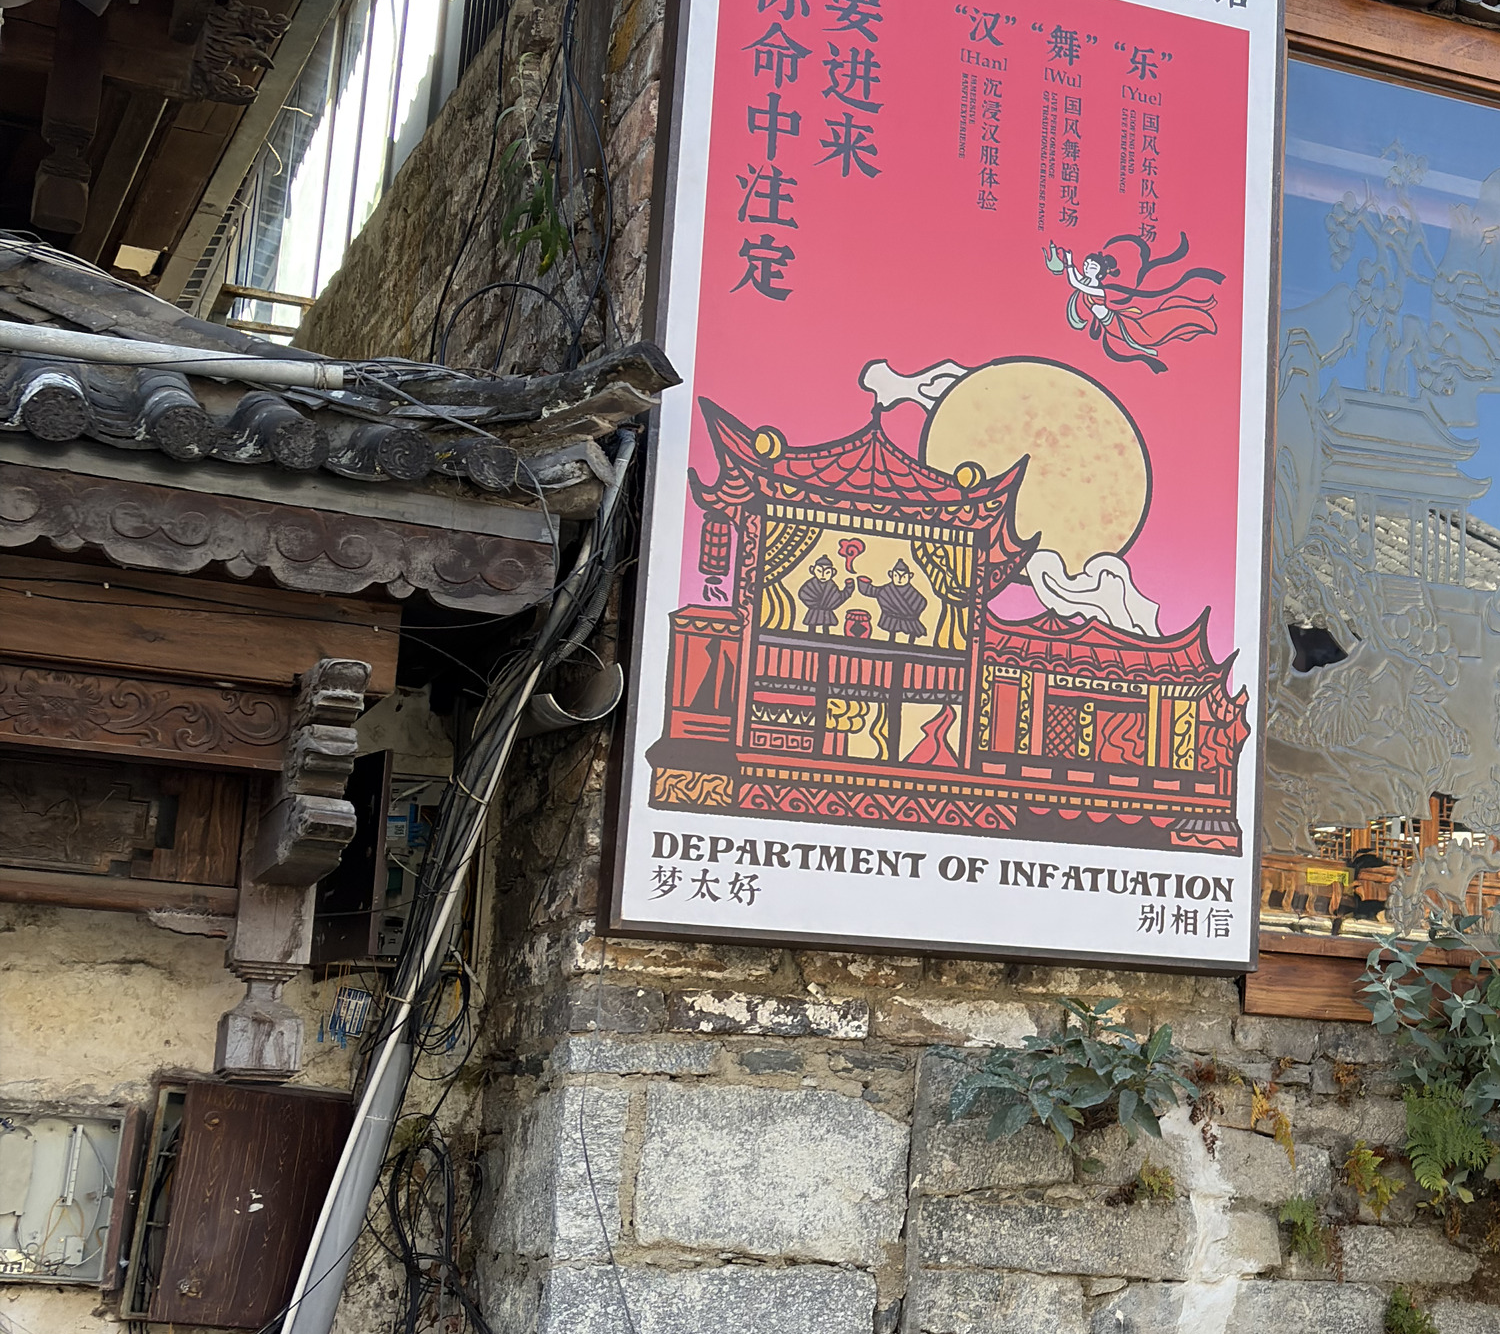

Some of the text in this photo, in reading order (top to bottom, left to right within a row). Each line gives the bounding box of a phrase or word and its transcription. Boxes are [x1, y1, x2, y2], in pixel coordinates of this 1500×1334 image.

[960, 48, 1008, 71] [Han]
[1044, 67, 1082, 89] [Wu]
[968, 74, 978, 125] IMMERSIVE
[1121, 85, 1162, 107] [Yue]
[958, 103, 968, 159] EXPERIENCE
[976, 77, 1003, 211] 沉浸汉服体验
[1048, 114, 1057, 179] PERFORMANCE
[1037, 90, 1050, 232] OF TRADITIONAL CHINESE DANCE
[1058, 95, 1082, 228] 国风舞蹈现场
[1119, 129, 1128, 194] PERFORMANCE
[1127, 151, 1135, 175] BAND
[1138, 112, 1161, 243] 国风乐队现场
[648, 865, 763, 908] 梦太好
[652, 830, 1235, 904] DEPARTMENT OF INFATUATION
[1136, 904, 1234, 939] 别相信
